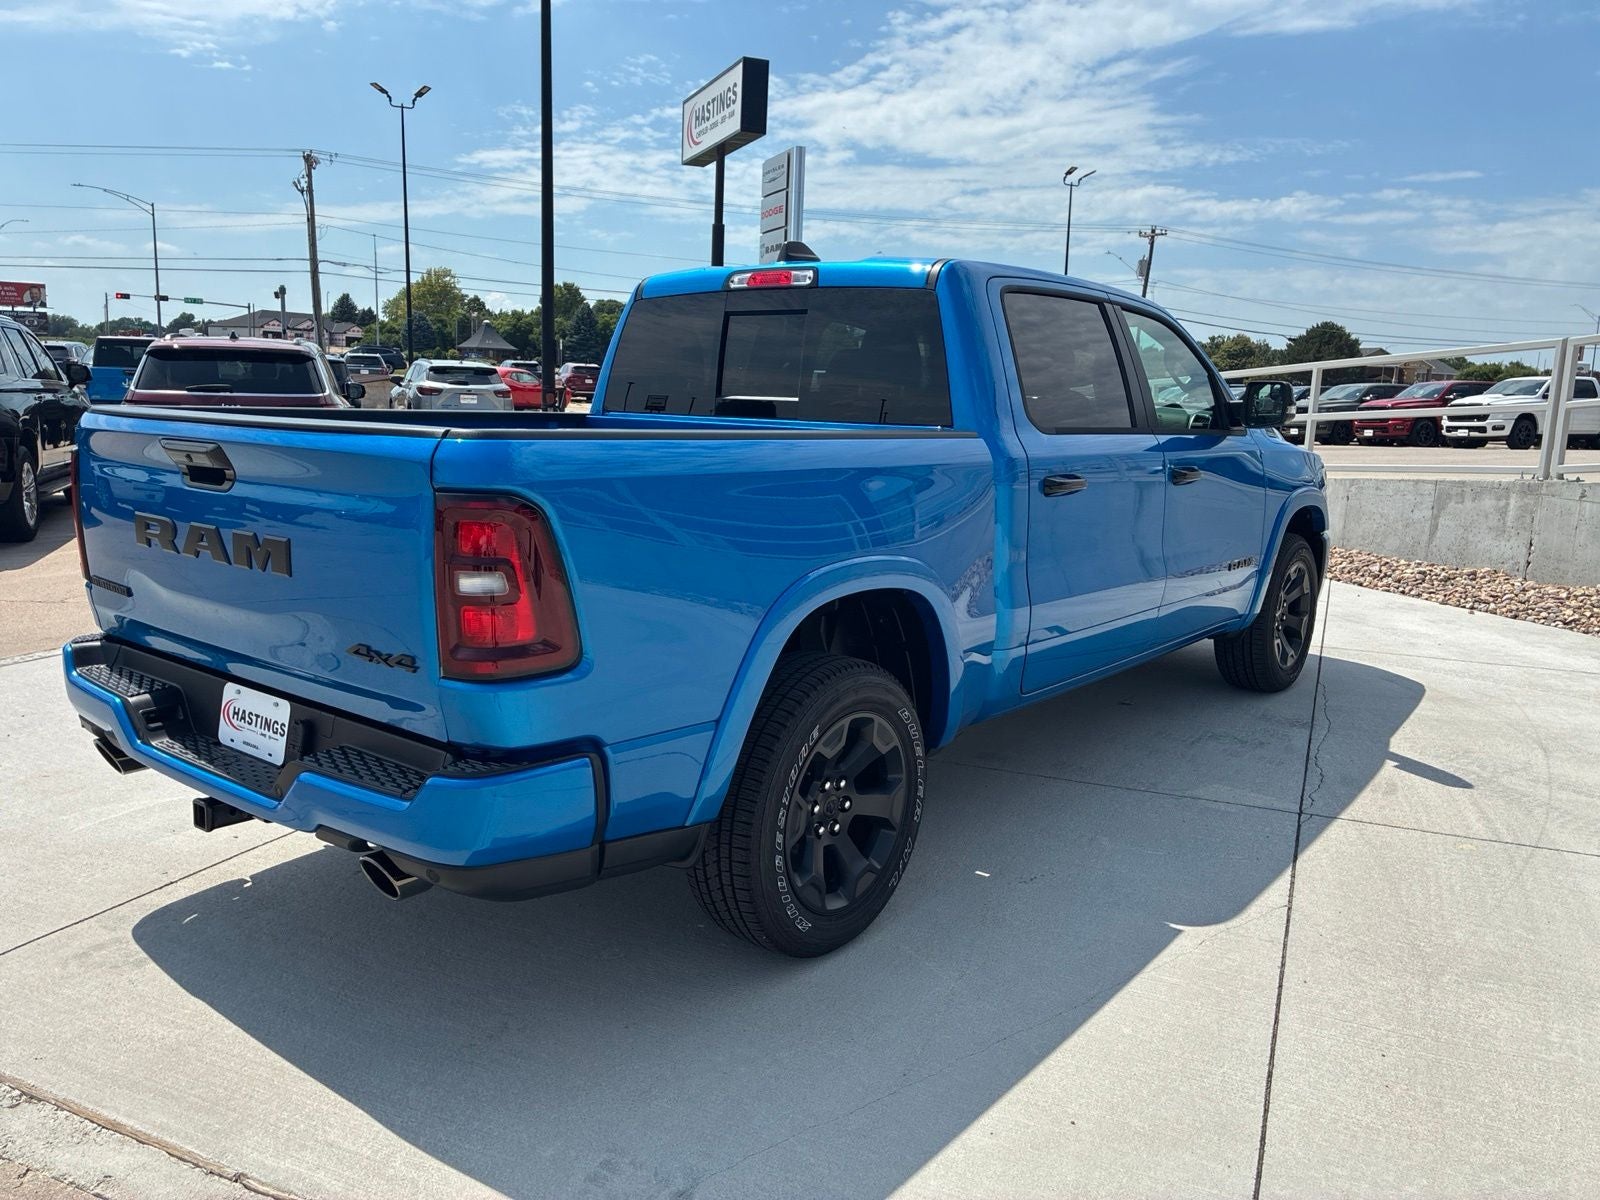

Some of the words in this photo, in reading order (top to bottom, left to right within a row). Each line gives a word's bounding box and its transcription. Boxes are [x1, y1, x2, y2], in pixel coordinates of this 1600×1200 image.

[694, 82, 738, 129] HASTINGS
[761, 204, 784, 220] DODGE
[765, 243, 784, 254] RAM
[134, 510, 293, 578] RAM
[232, 706, 287, 738] HASTINGS
[898, 707, 925, 823] DUELER
[775, 724, 821, 932] BRIDGESTONE
